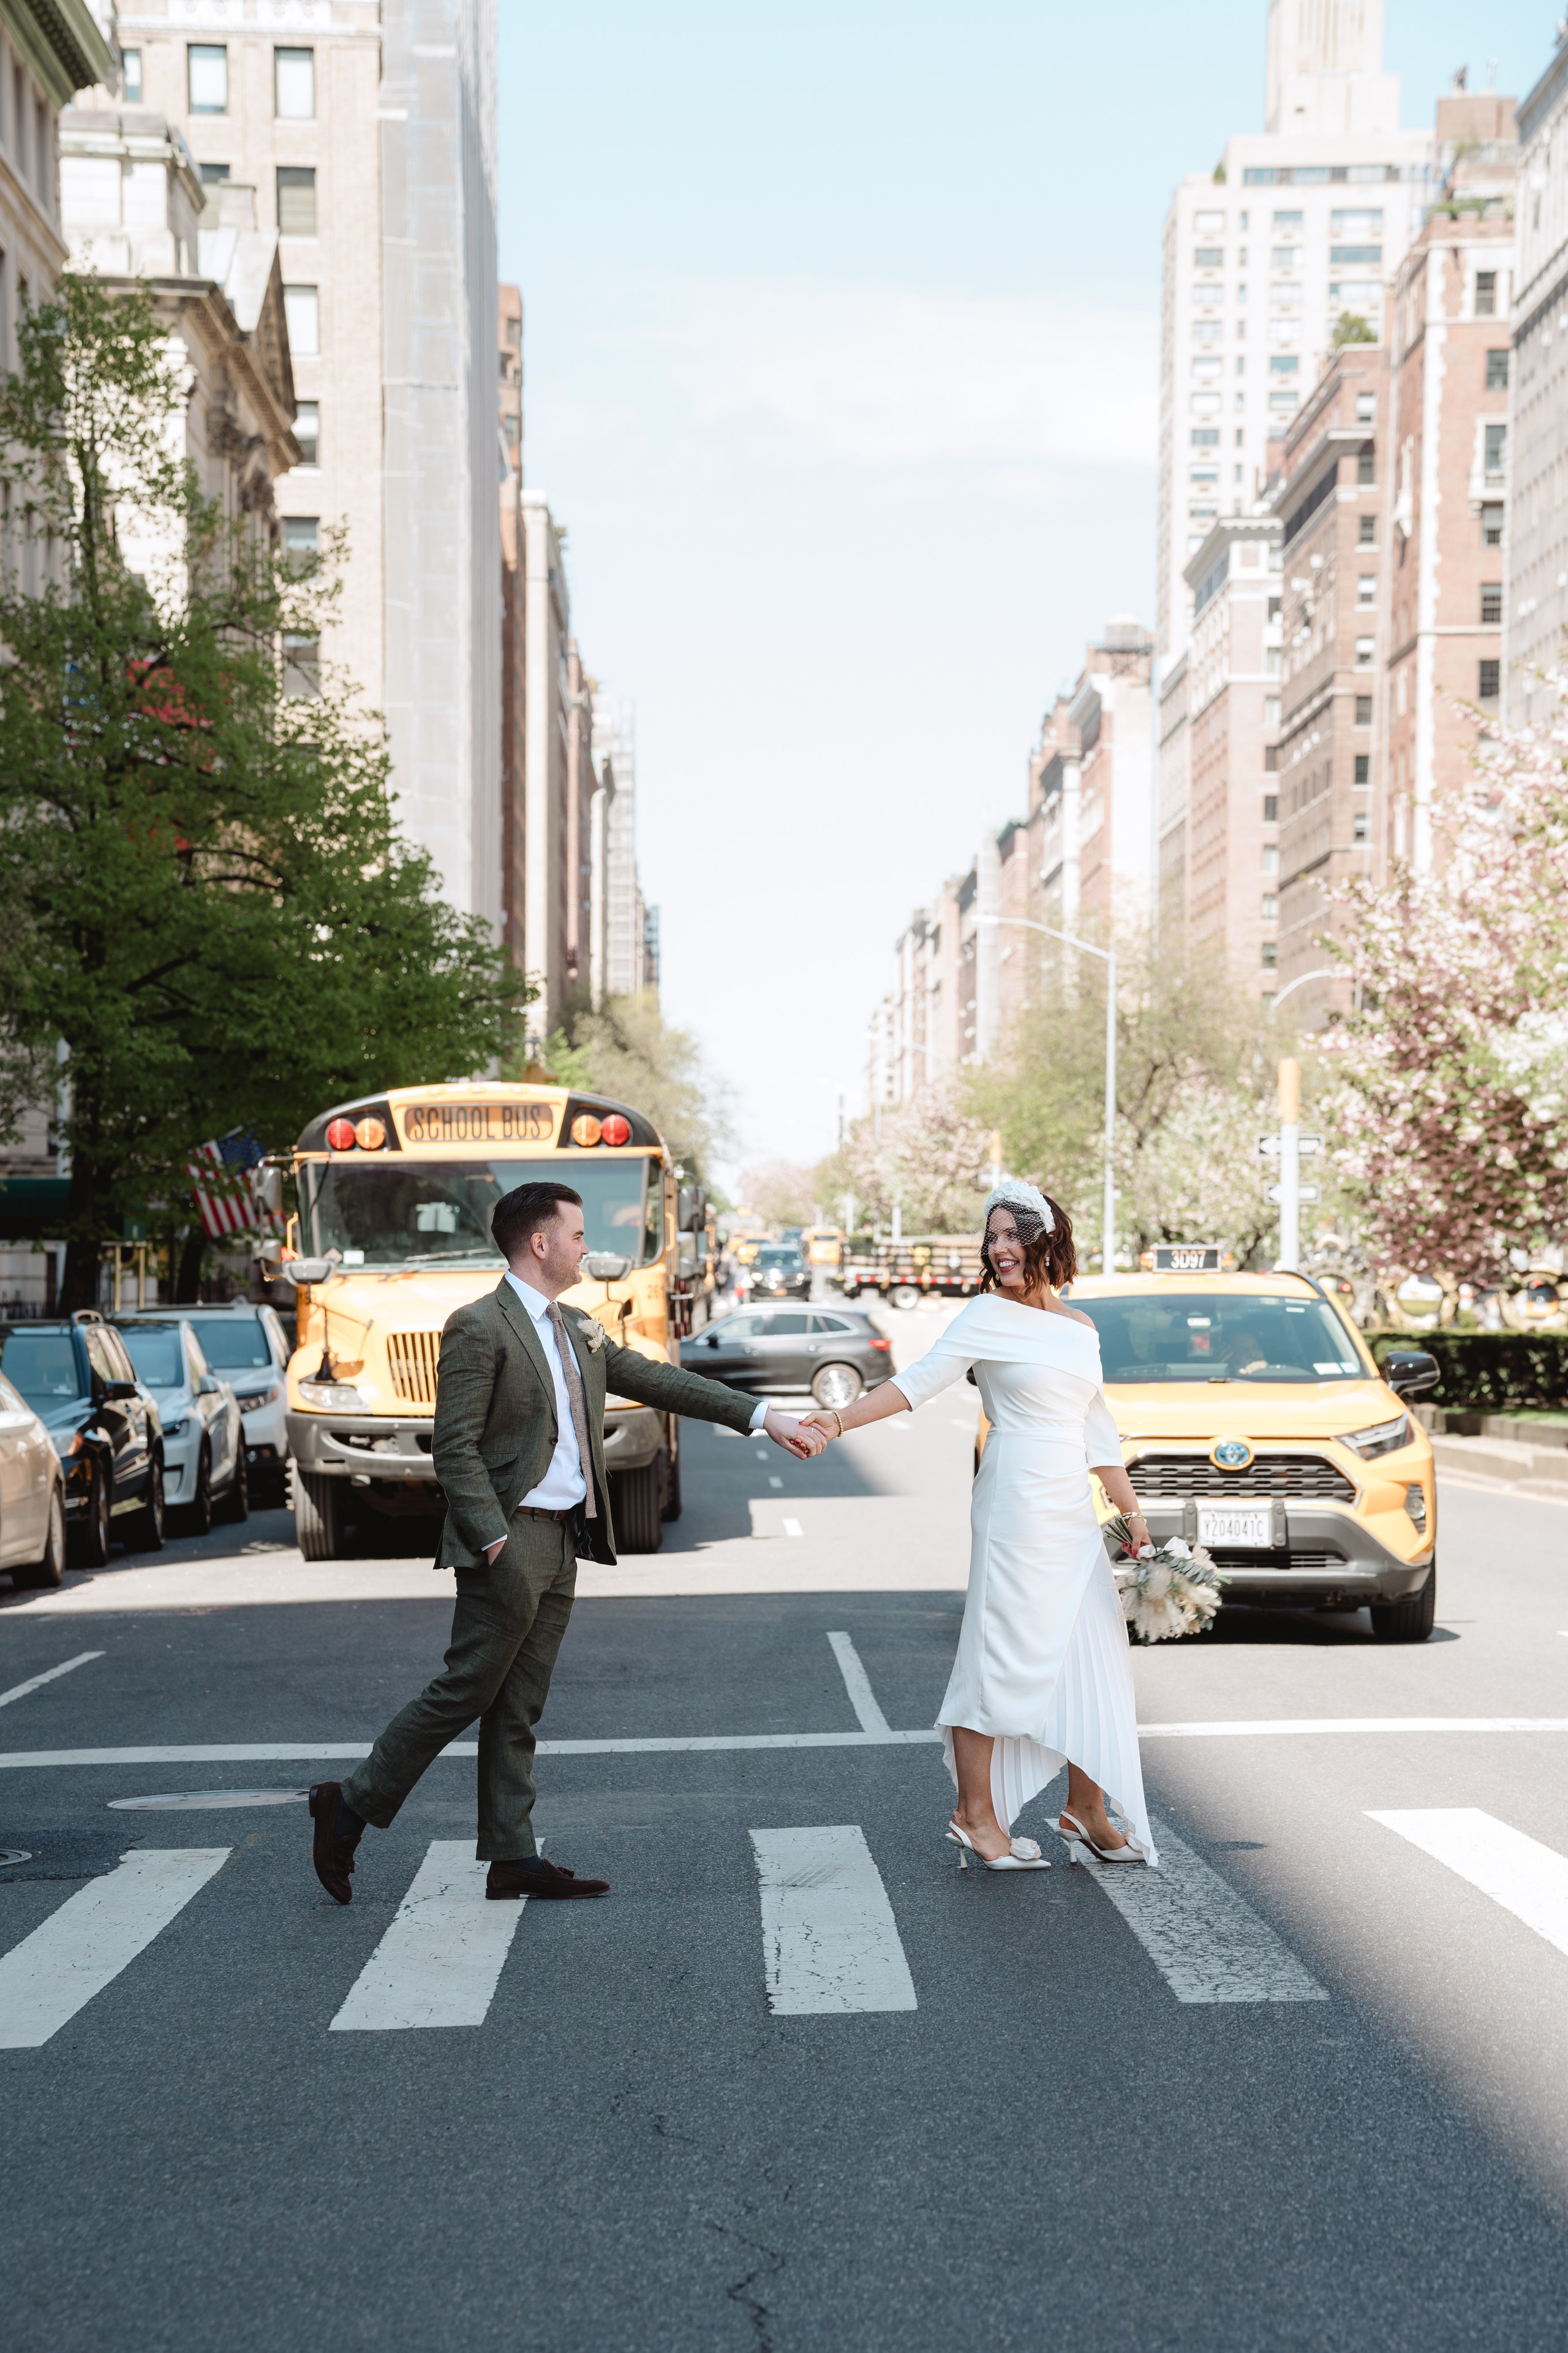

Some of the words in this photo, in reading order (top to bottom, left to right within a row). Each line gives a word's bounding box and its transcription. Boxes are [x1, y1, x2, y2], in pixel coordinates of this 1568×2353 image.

[414, 1106, 495, 1139] SCHOOL
[503, 1105, 540, 1139] BUS
[1170, 1249, 1207, 1269] 3D97
[1204, 1519, 1263, 1537] Y204041C
